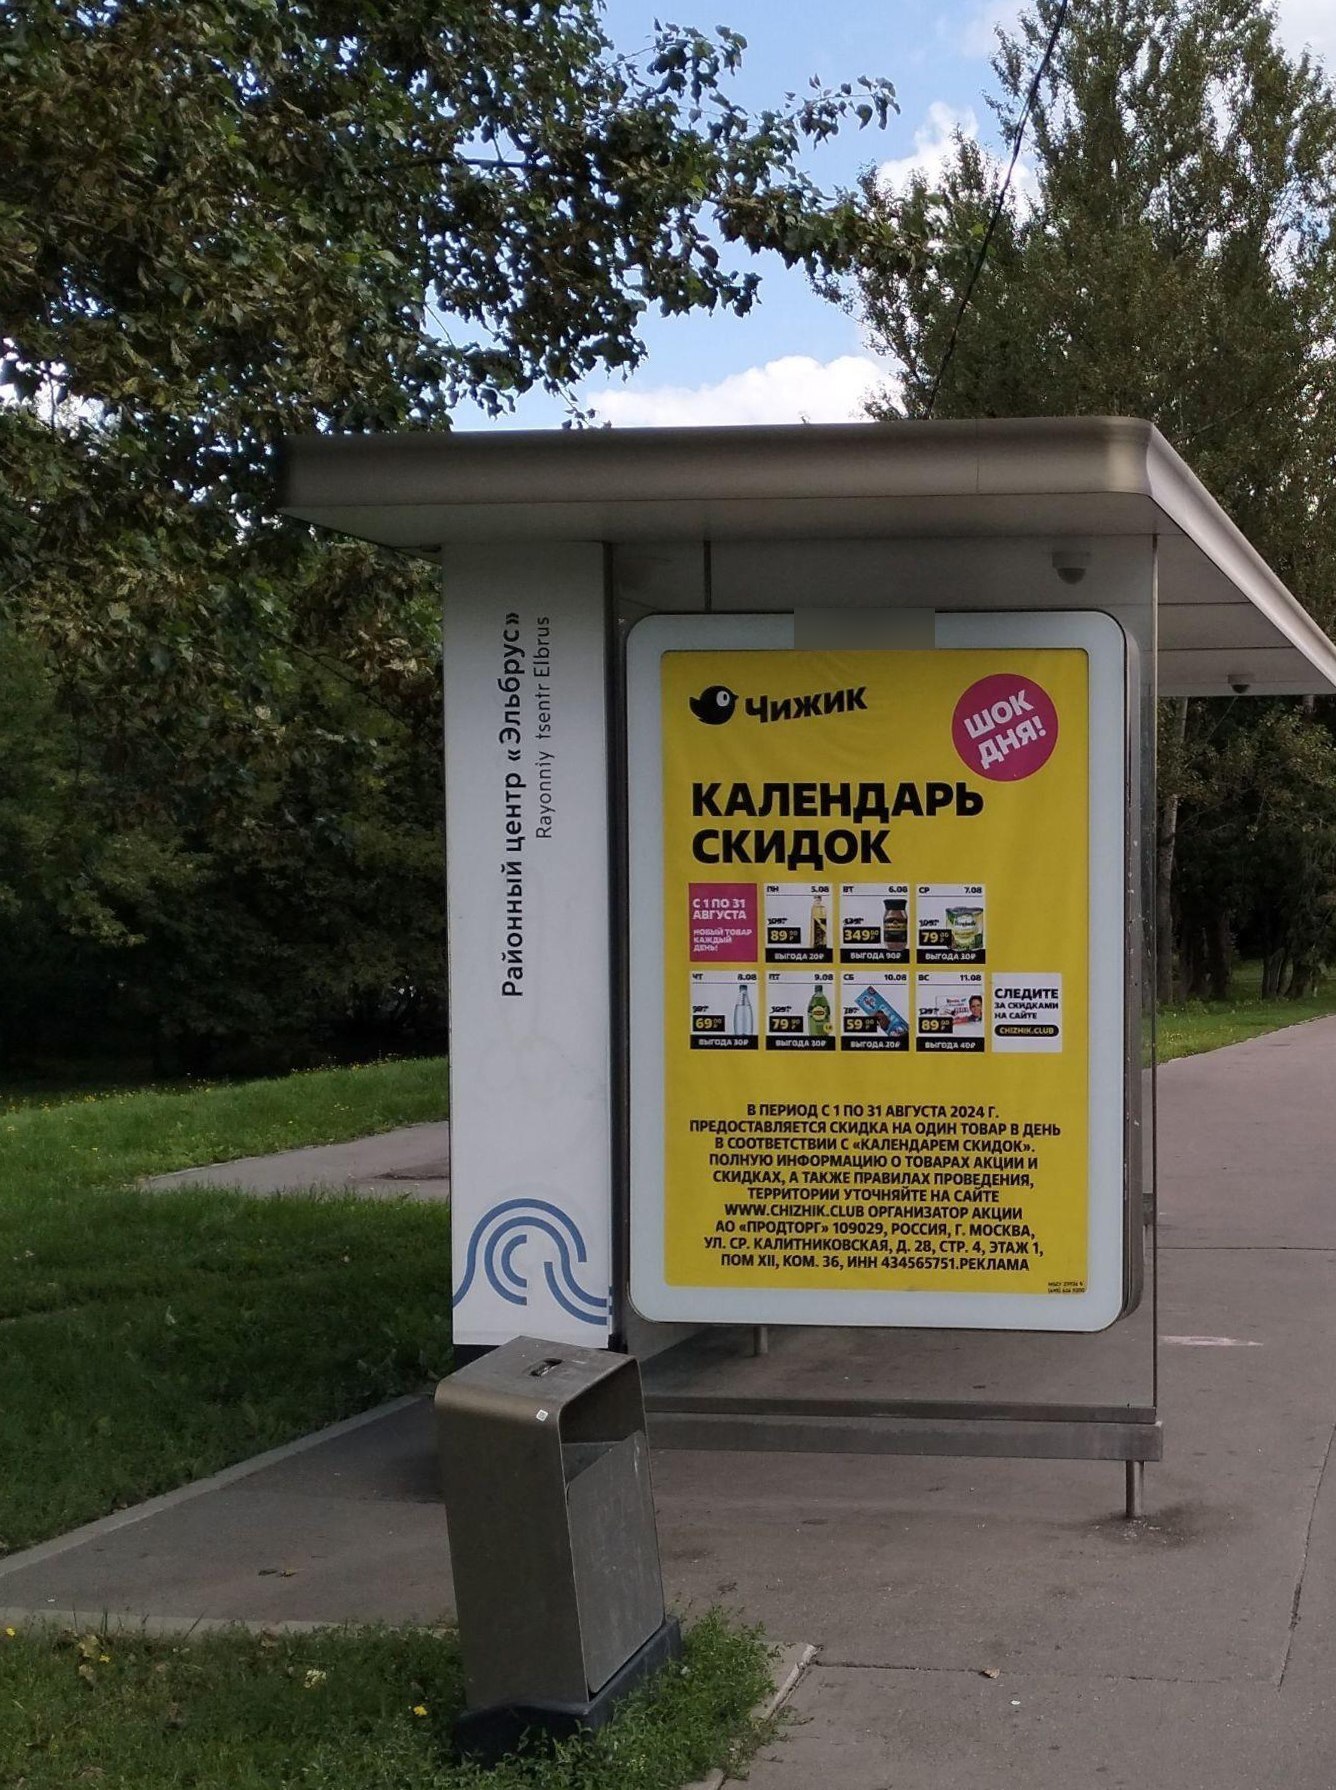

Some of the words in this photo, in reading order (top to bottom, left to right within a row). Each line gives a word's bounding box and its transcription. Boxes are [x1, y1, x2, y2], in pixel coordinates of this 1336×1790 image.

[534, 616, 551, 678] Elbrus
[498, 612, 526, 762] «Эльбрус»
[534, 685, 551, 741] tsentr
[963, 688, 1035, 740] ШОК
[977, 715, 1047, 770] ДНЯ!
[537, 751, 555, 839] Rayonniy
[693, 782, 984, 824] КАЛЕНДАРЬ
[503, 772, 528, 852] центр
[692, 829, 891, 871] СКИДОК
[693, 898, 700, 908] С
[704, 899, 708, 908] 1
[712, 899, 729, 908] ПО
[732, 898, 745, 908] 31
[693, 910, 746, 920] АВГУСТА
[501, 862, 524, 997] Районный
[693, 935, 732, 944] КАЖДЫЙ
[774, 953, 807, 961] ВЫГОДА
[850, 952, 884, 960] ВЫГОДА
[925, 953, 959, 961] ВЫГОДА
[994, 988, 1058, 1000] СЛЕДИТЕ
[1008, 1002, 1058, 1010] СКИДКАМИ
[1009, 1011, 1037, 1019] САЙТЕ
[999, 1027, 1054, 1035] CHIZHIK.CLUB
[699, 1039, 732, 1047] ВЫГОДА
[747, 1104, 756, 1116] В
[760, 1104, 818, 1118] ПЕРИОД
[822, 1104, 830, 1116] С
[833, 1105, 839, 1116] 1
[844, 1105, 864, 1116] ПО
[868, 1105, 881, 1117] 31
[886, 1105, 946, 1117] АВГУСТА
[950, 1106, 985, 1118] 2024
[988, 1106, 999, 1118] Г.
[690, 1120, 826, 1134] ПРЕДОСТАВЛЯЕТСЯ
[830, 1121, 888, 1136] СКИДКА
[892, 1122, 912, 1134] НА
[915, 1122, 956, 1136] ОДИН
[961, 1123, 1006, 1135] ТОВАР
[1010, 1123, 1019, 1135] В
[1023, 1124, 1060, 1138] ДЕНЬ
[715, 1137, 724, 1148] В
[728, 1138, 836, 1150] СООТВЕТСТВИИ
[841, 1138, 848, 1150] С
[853, 1139, 959, 1153] «КАЛЕНДАРЕМ
[963, 1140, 1035, 1154] СКИДОК».
[710, 1154, 773, 1166] ПОЛНУЮ
[777, 1155, 887, 1169] ИНФОРМАЦИЮ
[891, 1156, 901, 1167] О
[905, 1156, 970, 1168] ТОВАРАХ
[974, 1157, 1024, 1170] АКЦИИ
[1028, 1158, 1038, 1169] И
[713, 1170, 785, 1185] СКИДКАХ,
[789, 1171, 798, 1183] А
[802, 1172, 850, 1183] ТАКЖЕ
[854, 1172, 930, 1188] ПРАВИЛАХ
[934, 1173, 1034, 1189] ПРОВЕДЕНИЯ,
[748, 1188, 839, 1200] ТЕРРИТОРИИ
[844, 1189, 927, 1201] УТОЧНЯЙТЕ
[931, 1190, 950, 1202] НА
[954, 1190, 999, 1202] САЙТЕ
[724, 1204, 864, 1217] WWW.CHIZHIK.CLUB
[868, 1206, 968, 1219] ОРГАНИЗАТОР
[972, 1208, 1022, 1221] АКЦИИ
[716, 1220, 735, 1232] АО
[739, 1221, 828, 1235] «ПРОДТОРГ»
[833, 1222, 888, 1237] 109029,
[892, 1223, 951, 1238] РОССИЯ,
[955, 1224, 966, 1236] Г.
[970, 1224, 1035, 1240] МОСКВА,
[704, 1237, 726, 1249] УЛ.
[730, 1238, 750, 1249] СР.
[754, 1238, 892, 1254] КАЛИТНИКОВСКАЯ,
[896, 1240, 910, 1254] Д.
[915, 1240, 936, 1255] 28,
[939, 1240, 968, 1253] СТР.
[972, 1241, 985, 1256] 4,
[990, 1241, 1028, 1254] ЭТАЖ
[1032, 1242, 1043, 1257] 1,
[721, 1254, 754, 1266] ПОМ
[758, 1255, 779, 1269] XII,
[783, 1255, 819, 1267] КОМ.
[823, 1256, 844, 1270] 36,
[848, 1256, 877, 1268] ИНН
[881, 1257, 1029, 1271] 434565751.РЕКЛАМА
